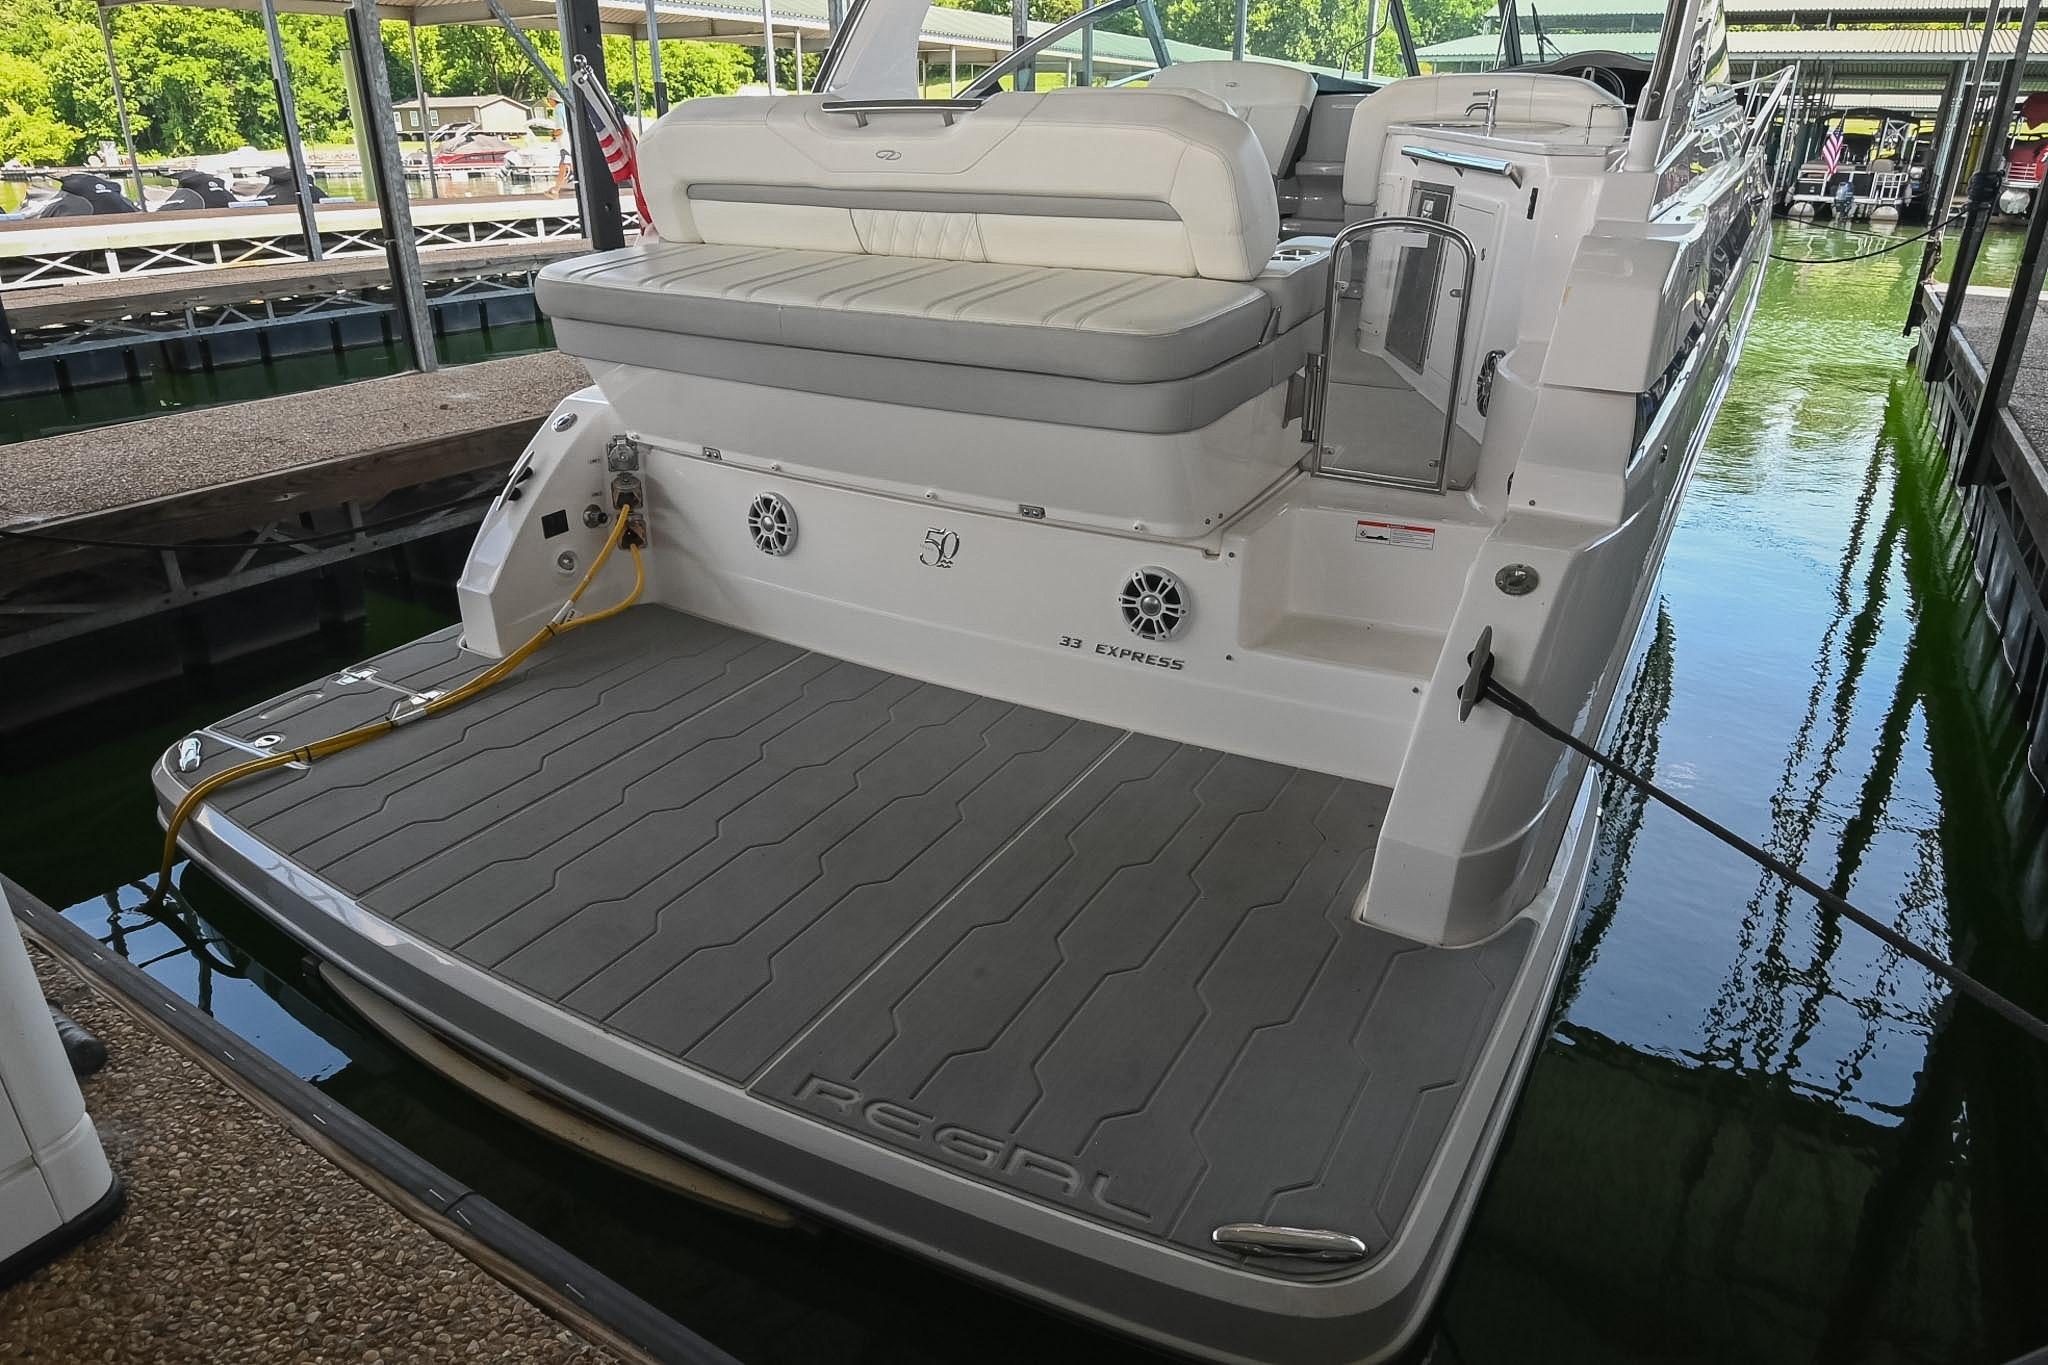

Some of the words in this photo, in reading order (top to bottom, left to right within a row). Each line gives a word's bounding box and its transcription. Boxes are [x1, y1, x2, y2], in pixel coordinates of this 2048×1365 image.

[920, 527, 960, 567] 50
[1059, 635, 1083, 649] 33
[1095, 643, 1185, 671] EXPRESS
[793, 1073, 1152, 1224] REGAL
